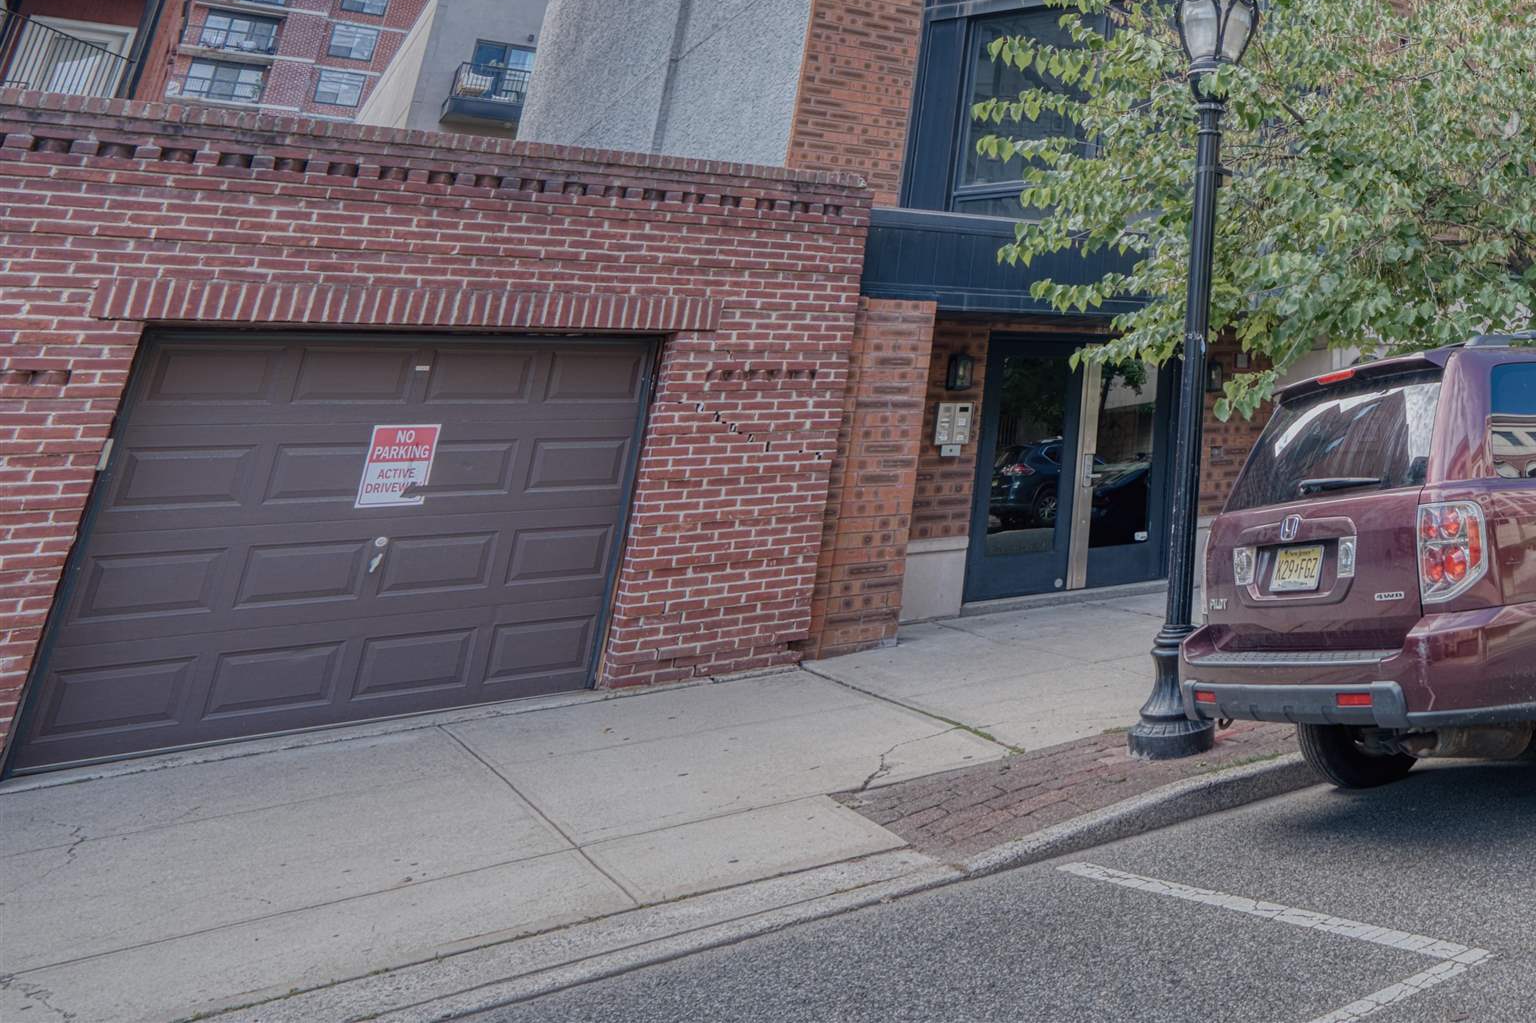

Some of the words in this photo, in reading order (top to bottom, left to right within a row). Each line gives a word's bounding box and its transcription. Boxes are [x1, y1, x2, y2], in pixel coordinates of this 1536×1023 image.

[396, 430, 416, 443] NO
[373, 445, 430, 460] PARKING
[377, 468, 416, 480] ACTIVE
